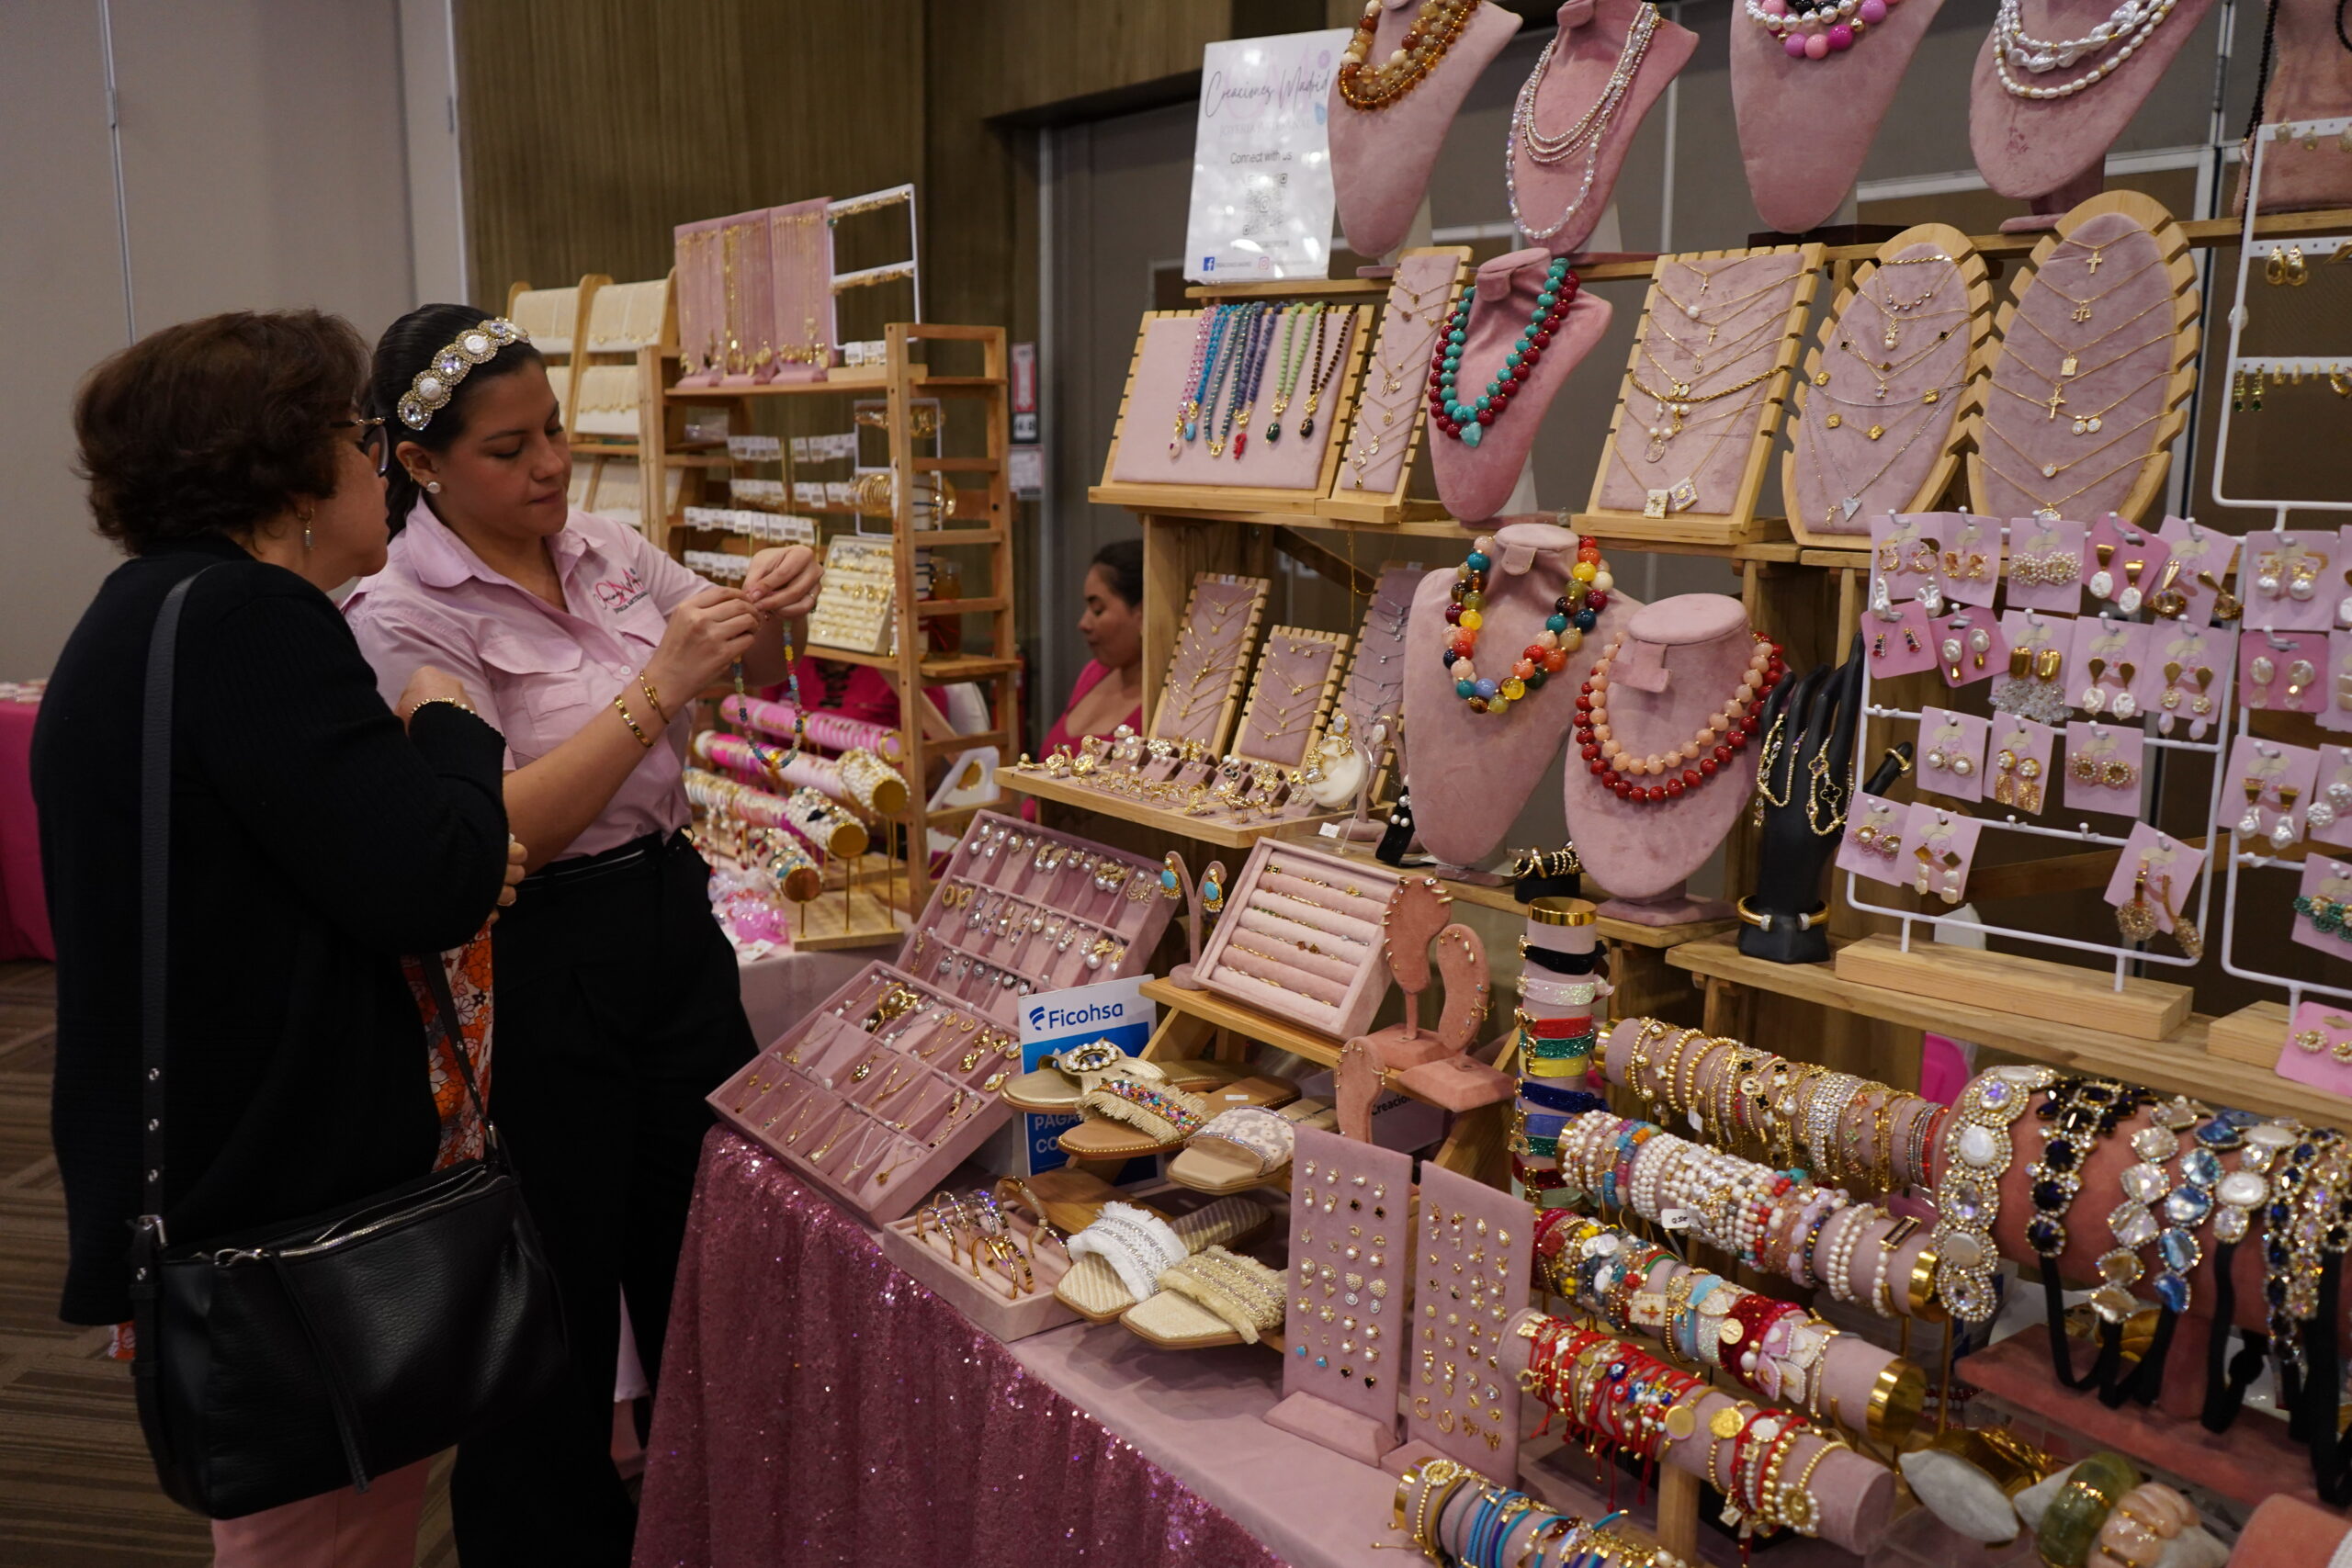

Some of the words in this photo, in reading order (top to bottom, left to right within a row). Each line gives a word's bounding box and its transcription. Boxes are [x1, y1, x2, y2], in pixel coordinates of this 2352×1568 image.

[1230, 152, 1263, 164] Connect
[1264, 150, 1281, 162] with
[1048, 1003, 1124, 1029] Ficohsa
[1371, 1094, 1414, 1116] Creacio
